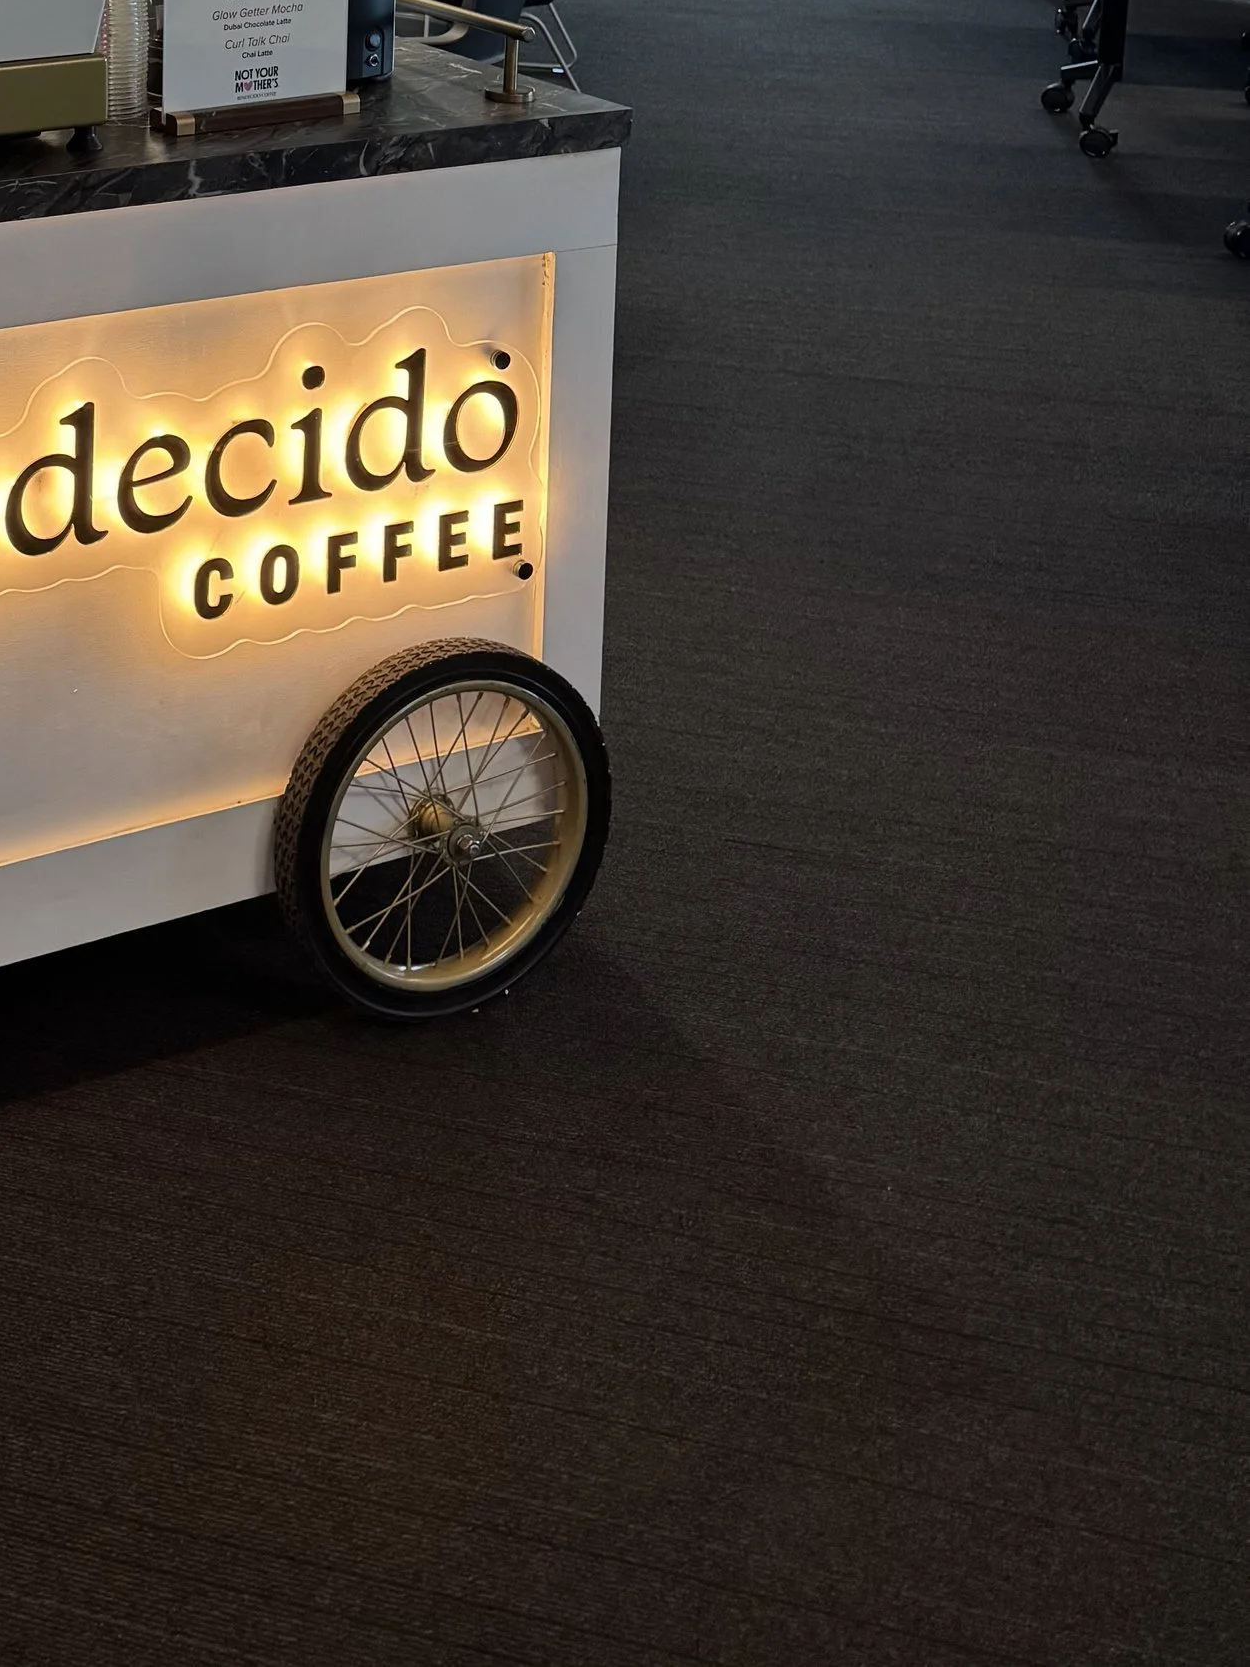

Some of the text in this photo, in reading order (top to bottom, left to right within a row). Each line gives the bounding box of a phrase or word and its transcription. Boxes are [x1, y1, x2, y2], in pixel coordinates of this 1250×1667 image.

[212, 3, 303, 21] Glow Getter Mocha
[224, 23, 242, 31] Dubai
[244, 19, 275, 29] Chocolate
[225, 33, 291, 49] Curl Talk Chai
[242, 49, 273, 59] Chai Latte
[235, 65, 279, 81] NOT YOUR
[193, 498, 526, 621] COFFEE
